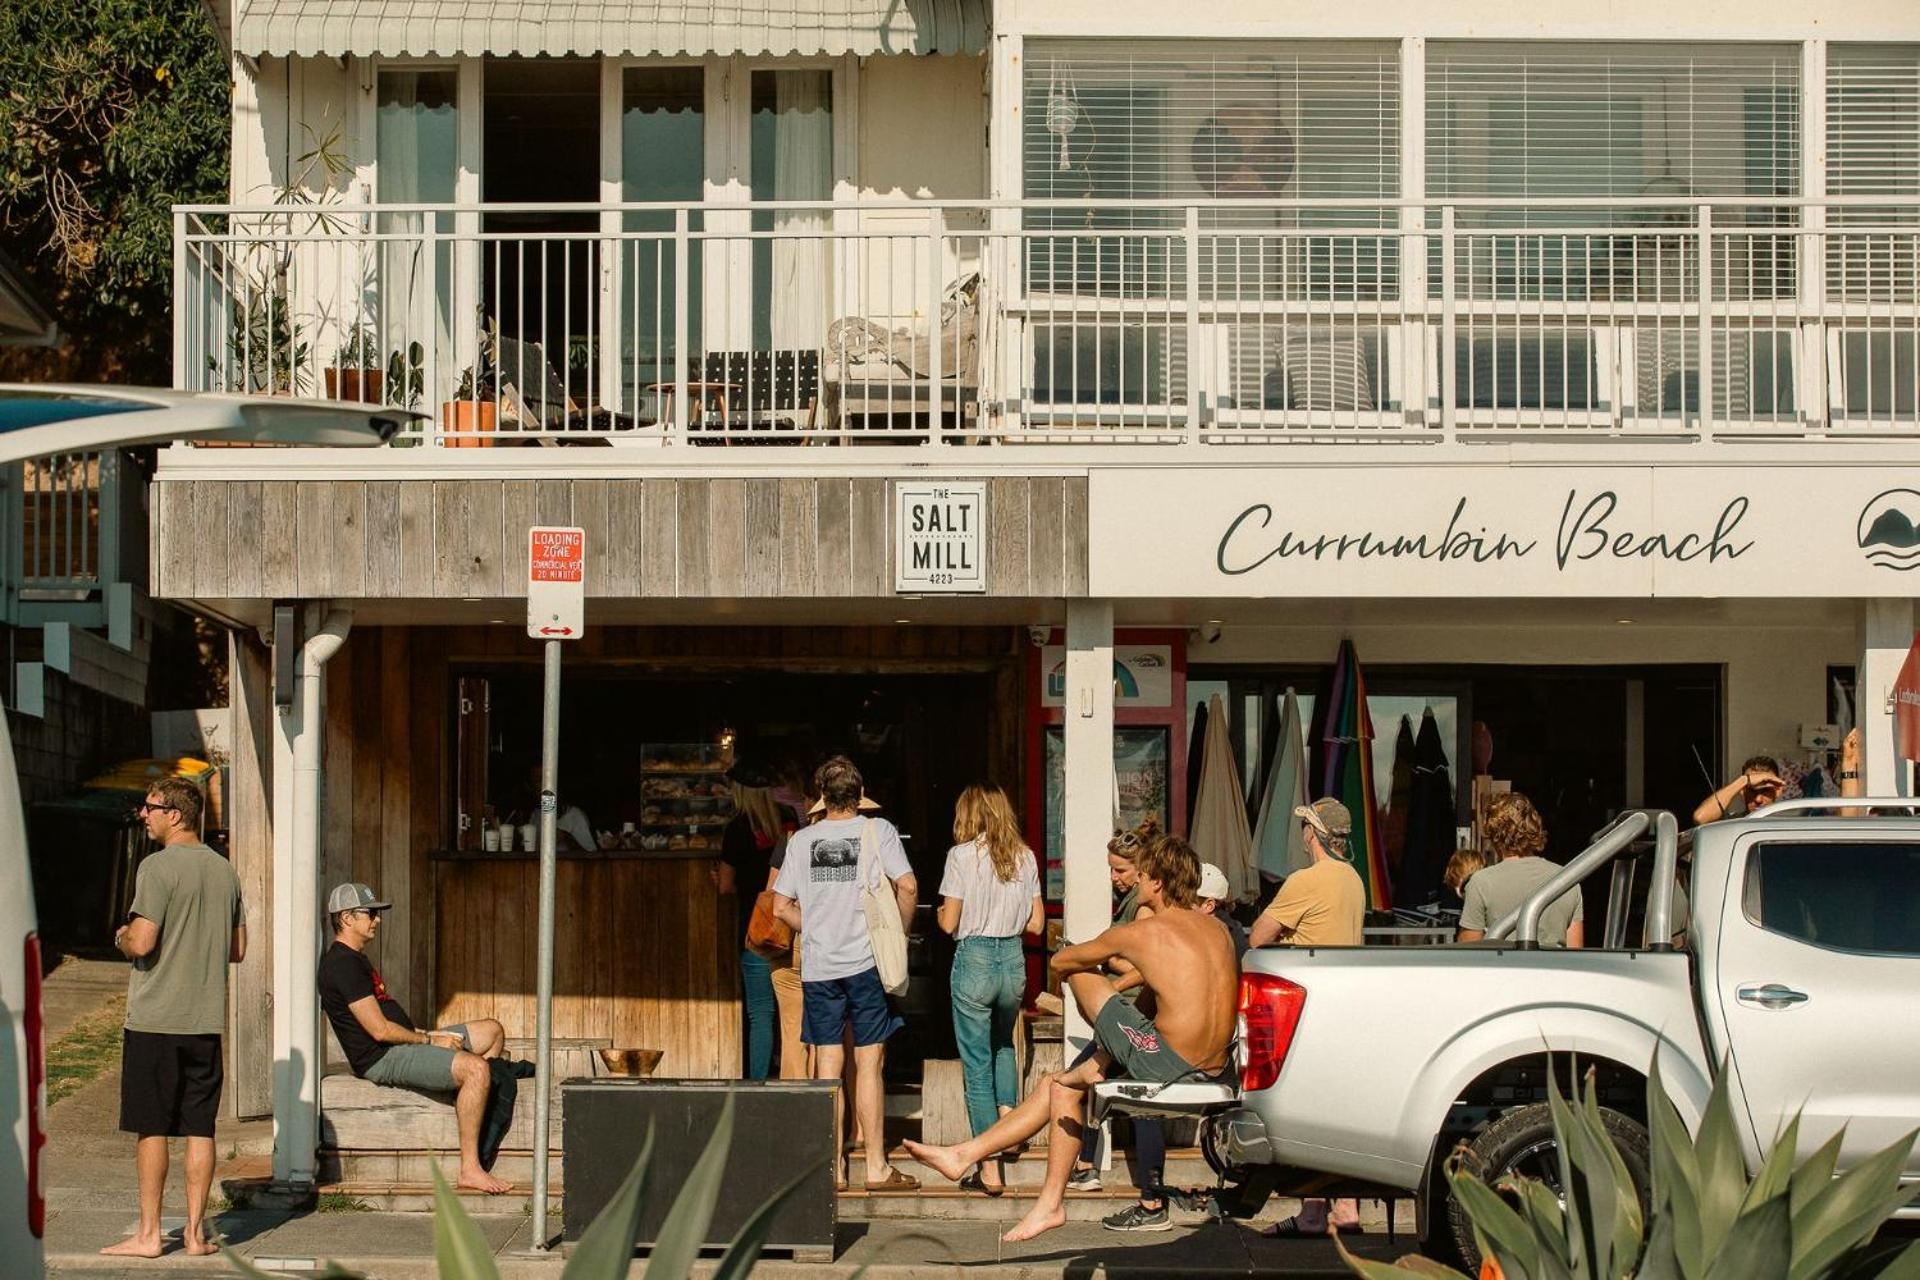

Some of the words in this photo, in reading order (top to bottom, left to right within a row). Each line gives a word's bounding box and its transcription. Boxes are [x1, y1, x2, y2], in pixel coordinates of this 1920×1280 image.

[933, 488, 949, 499] THE
[912, 504, 971, 532] SALT
[534, 532, 580, 545] LOADING
[1217, 496, 1538, 576] Currumbin
[1556, 489, 1756, 572] Beach
[542, 545, 571, 558] ZONE
[913, 541, 972, 569] MILL
[929, 573, 953, 584] 4223
